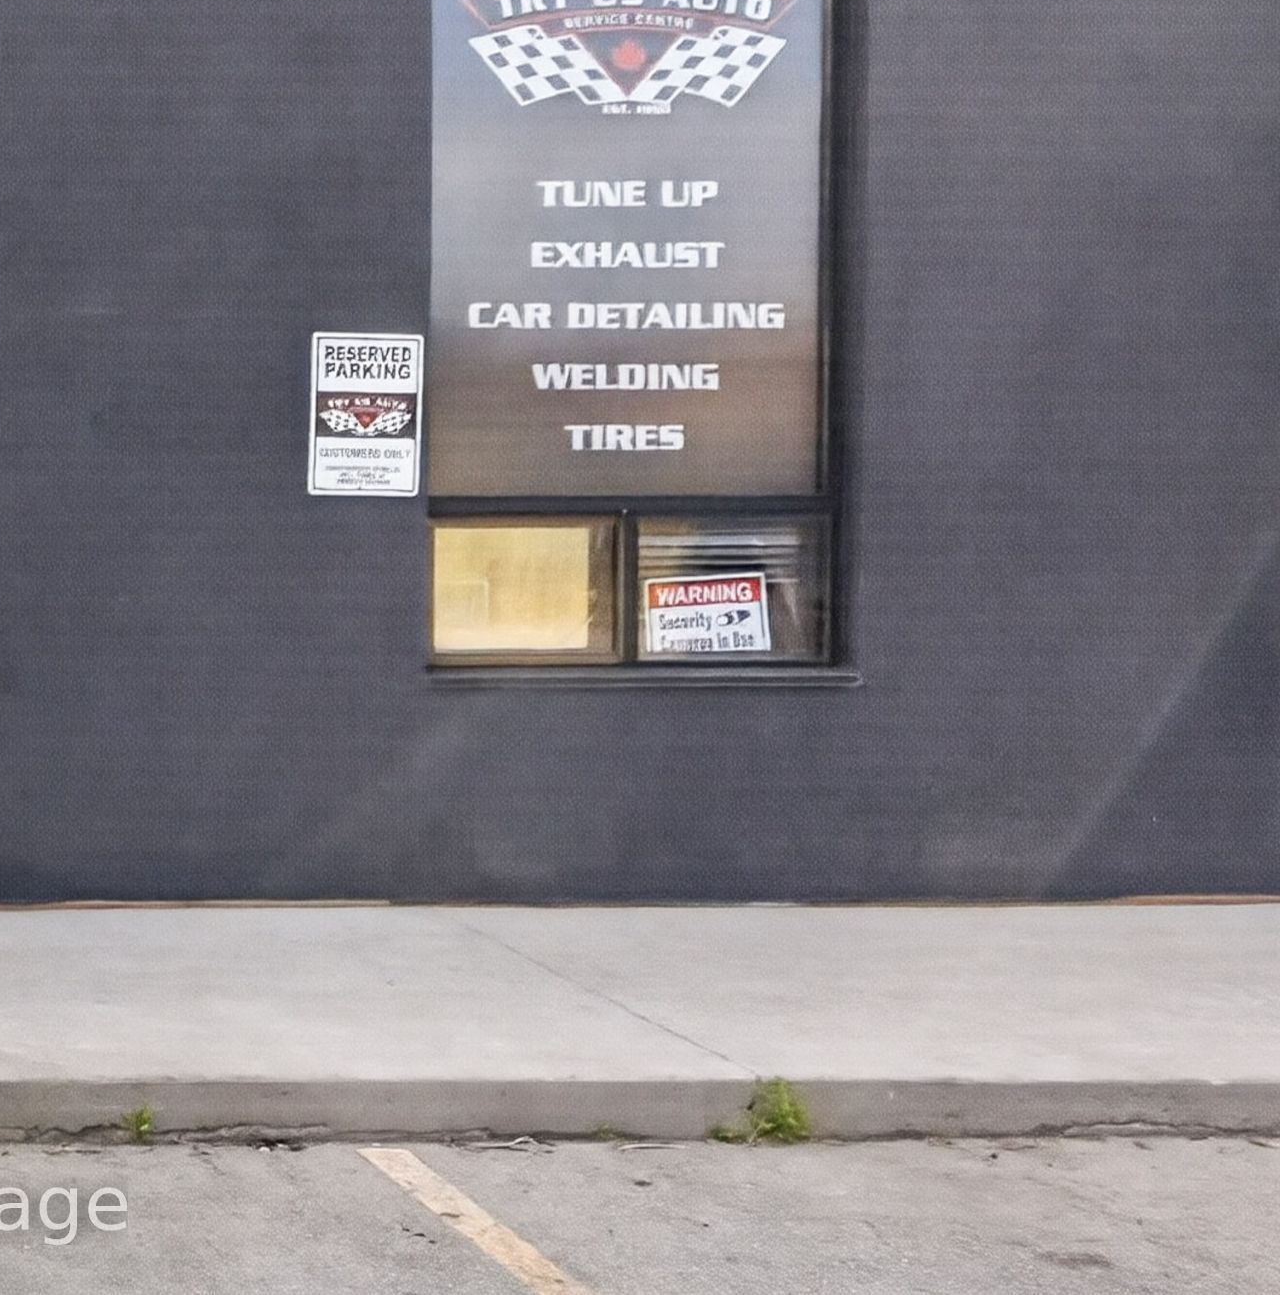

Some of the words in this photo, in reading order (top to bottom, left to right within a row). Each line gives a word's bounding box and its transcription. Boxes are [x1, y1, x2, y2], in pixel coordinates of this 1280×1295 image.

[536, 180, 646, 207] TUNE
[661, 180, 719, 207] UP
[531, 242, 725, 268] EXHAUST
[468, 303, 551, 329] CAR
[568, 303, 785, 329] DETAILING
[325, 345, 412, 363] RESERVED
[324, 362, 411, 380] PARKING
[532, 364, 719, 390] WELDING
[564, 424, 685, 451] TIRES
[656, 582, 753, 605] WARNING
[659, 611, 712, 631] Security
